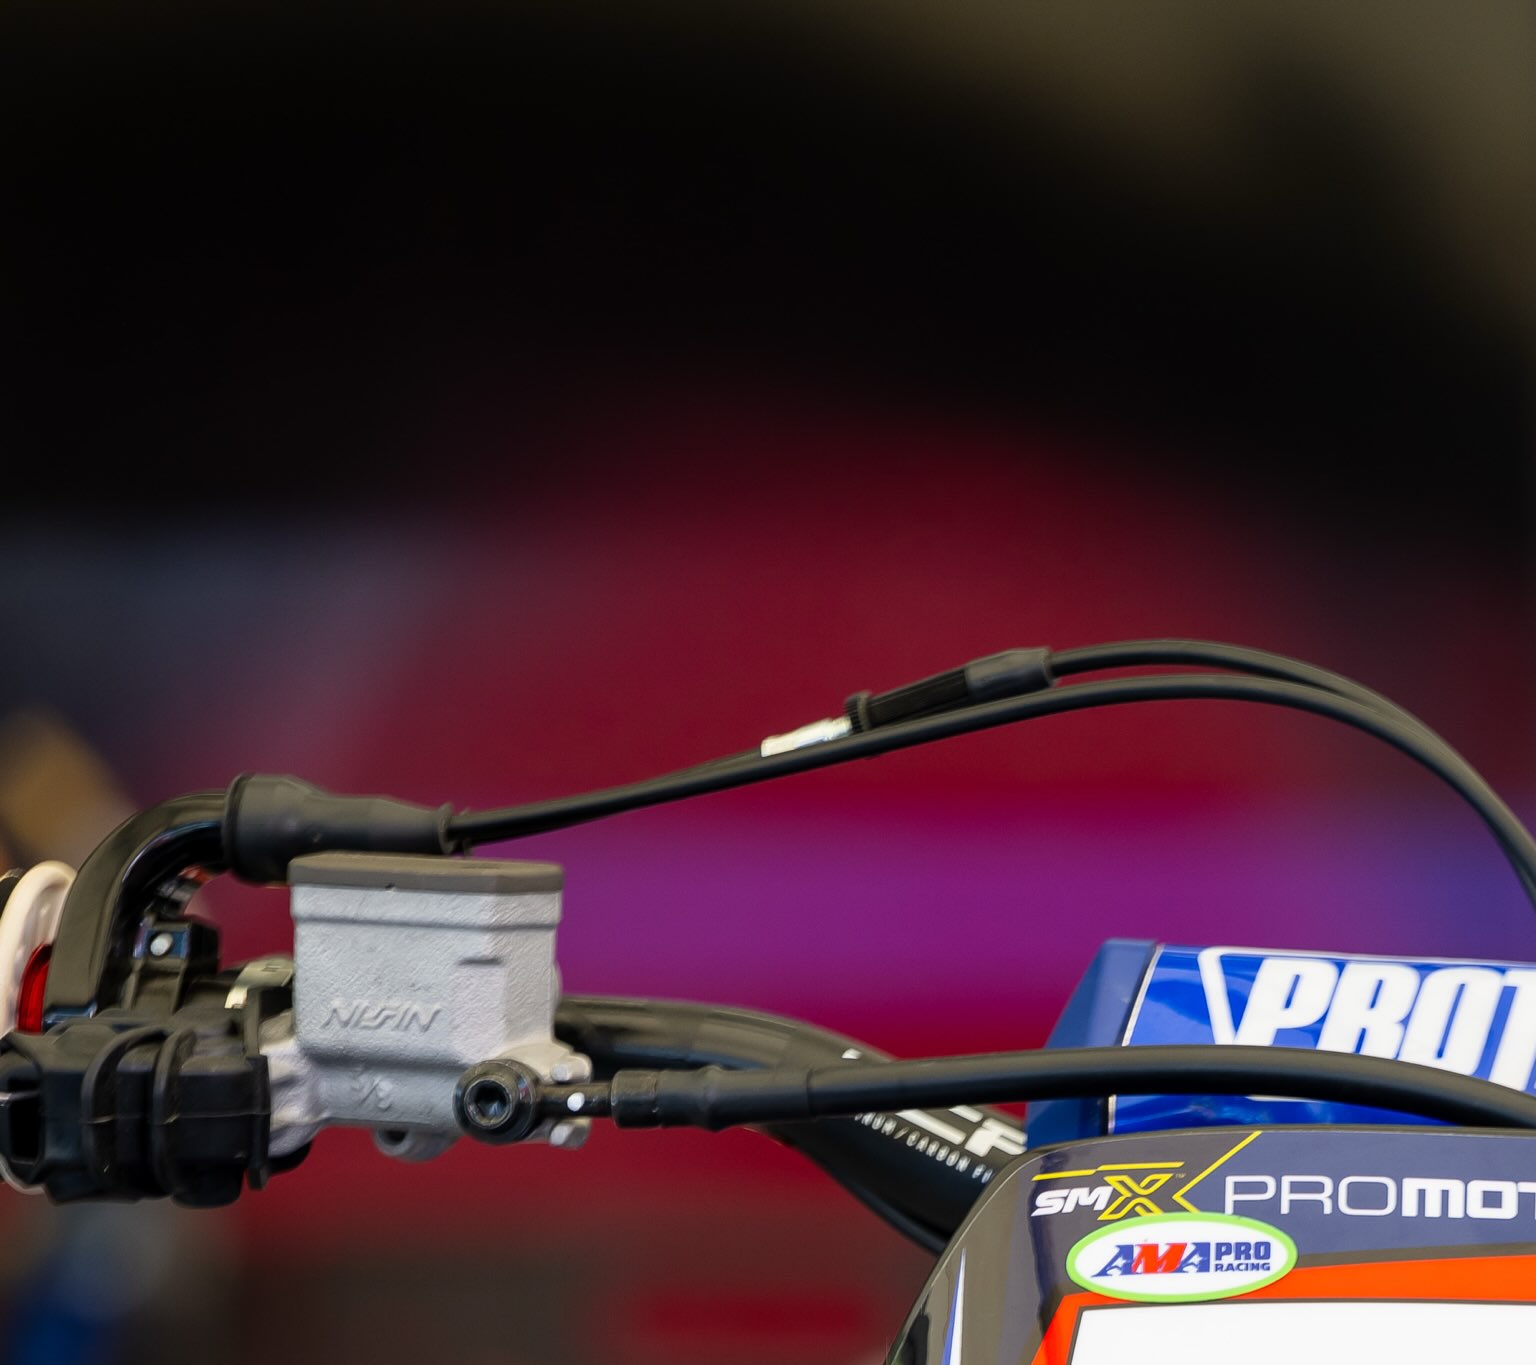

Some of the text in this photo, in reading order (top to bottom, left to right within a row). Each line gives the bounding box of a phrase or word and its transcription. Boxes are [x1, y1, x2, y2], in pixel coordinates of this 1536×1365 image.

[1090, 1240, 1272, 1278] AMA PRO
[1213, 1261, 1272, 1273] RACING
